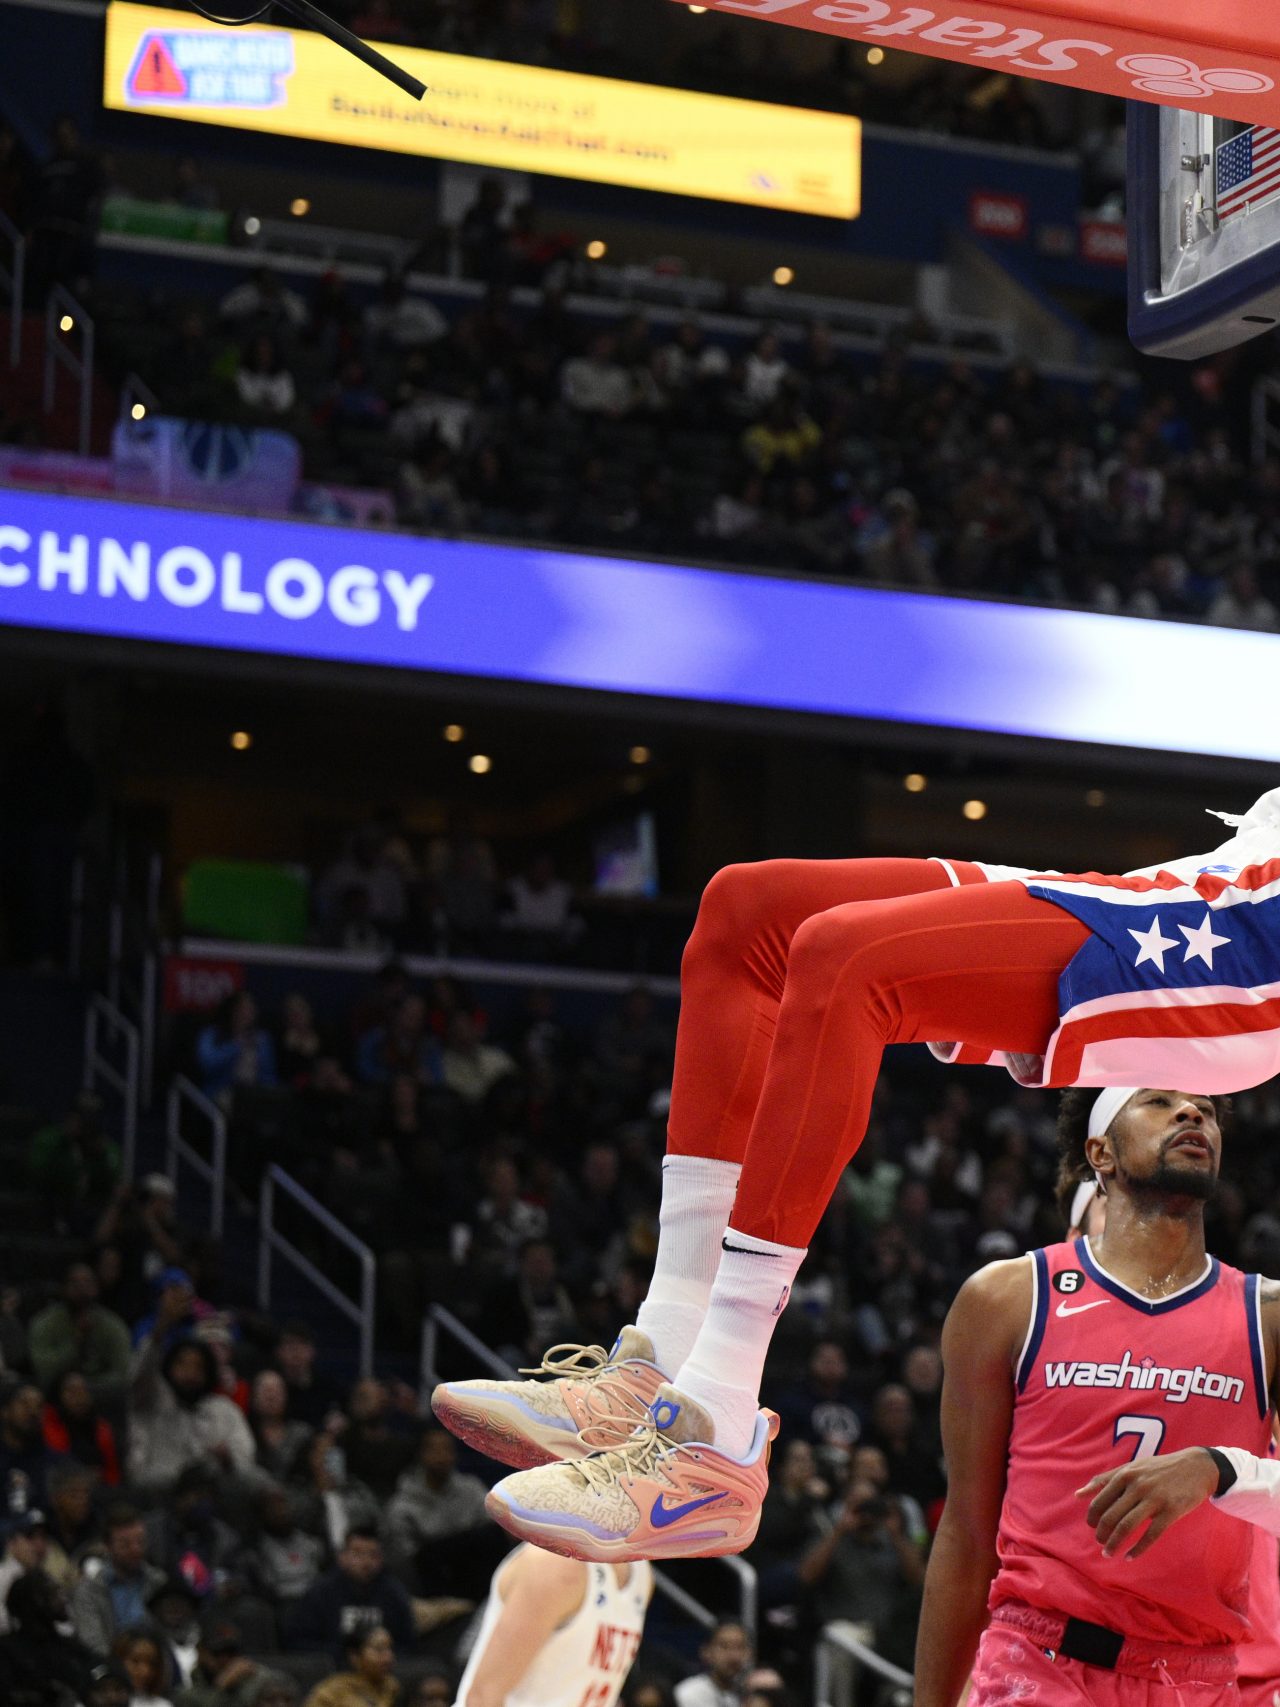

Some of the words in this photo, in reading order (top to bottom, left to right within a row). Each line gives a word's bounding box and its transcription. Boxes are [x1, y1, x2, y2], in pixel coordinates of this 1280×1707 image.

[0, 525, 434, 631] CHNOLOGY
[1059, 1271, 1079, 1293] 6
[1044, 1350, 1246, 1404] washington
